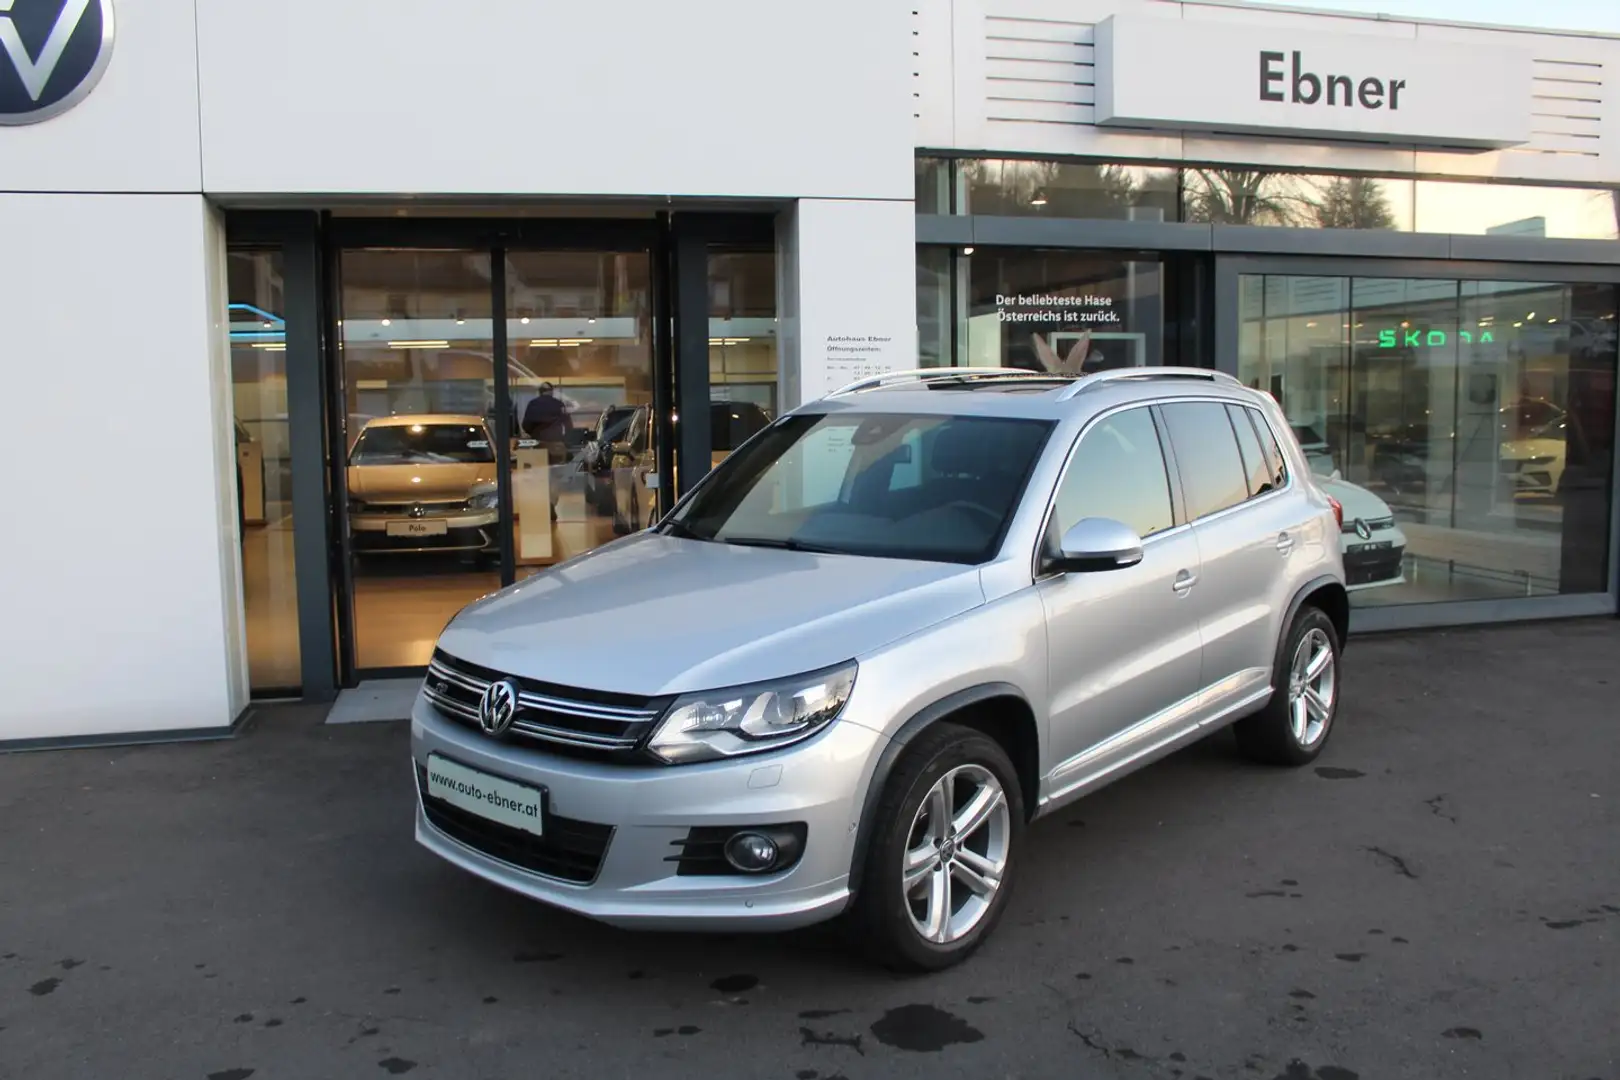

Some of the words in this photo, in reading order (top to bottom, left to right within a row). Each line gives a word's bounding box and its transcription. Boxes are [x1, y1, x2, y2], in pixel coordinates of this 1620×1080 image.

[1259, 50, 1406, 110] Ebner
[995, 294, 1015, 305] Der
[1018, 294, 1082, 305] beliebteste
[1084, 294, 1112, 305] Hase
[997, 308, 1061, 322] Österreichs
[1064, 310, 1078, 322] ist
[1080, 310, 1120, 322] zurück.
[408, 523, 427, 532] Polo
[430, 771, 538, 818] www.auto-ebner.at
